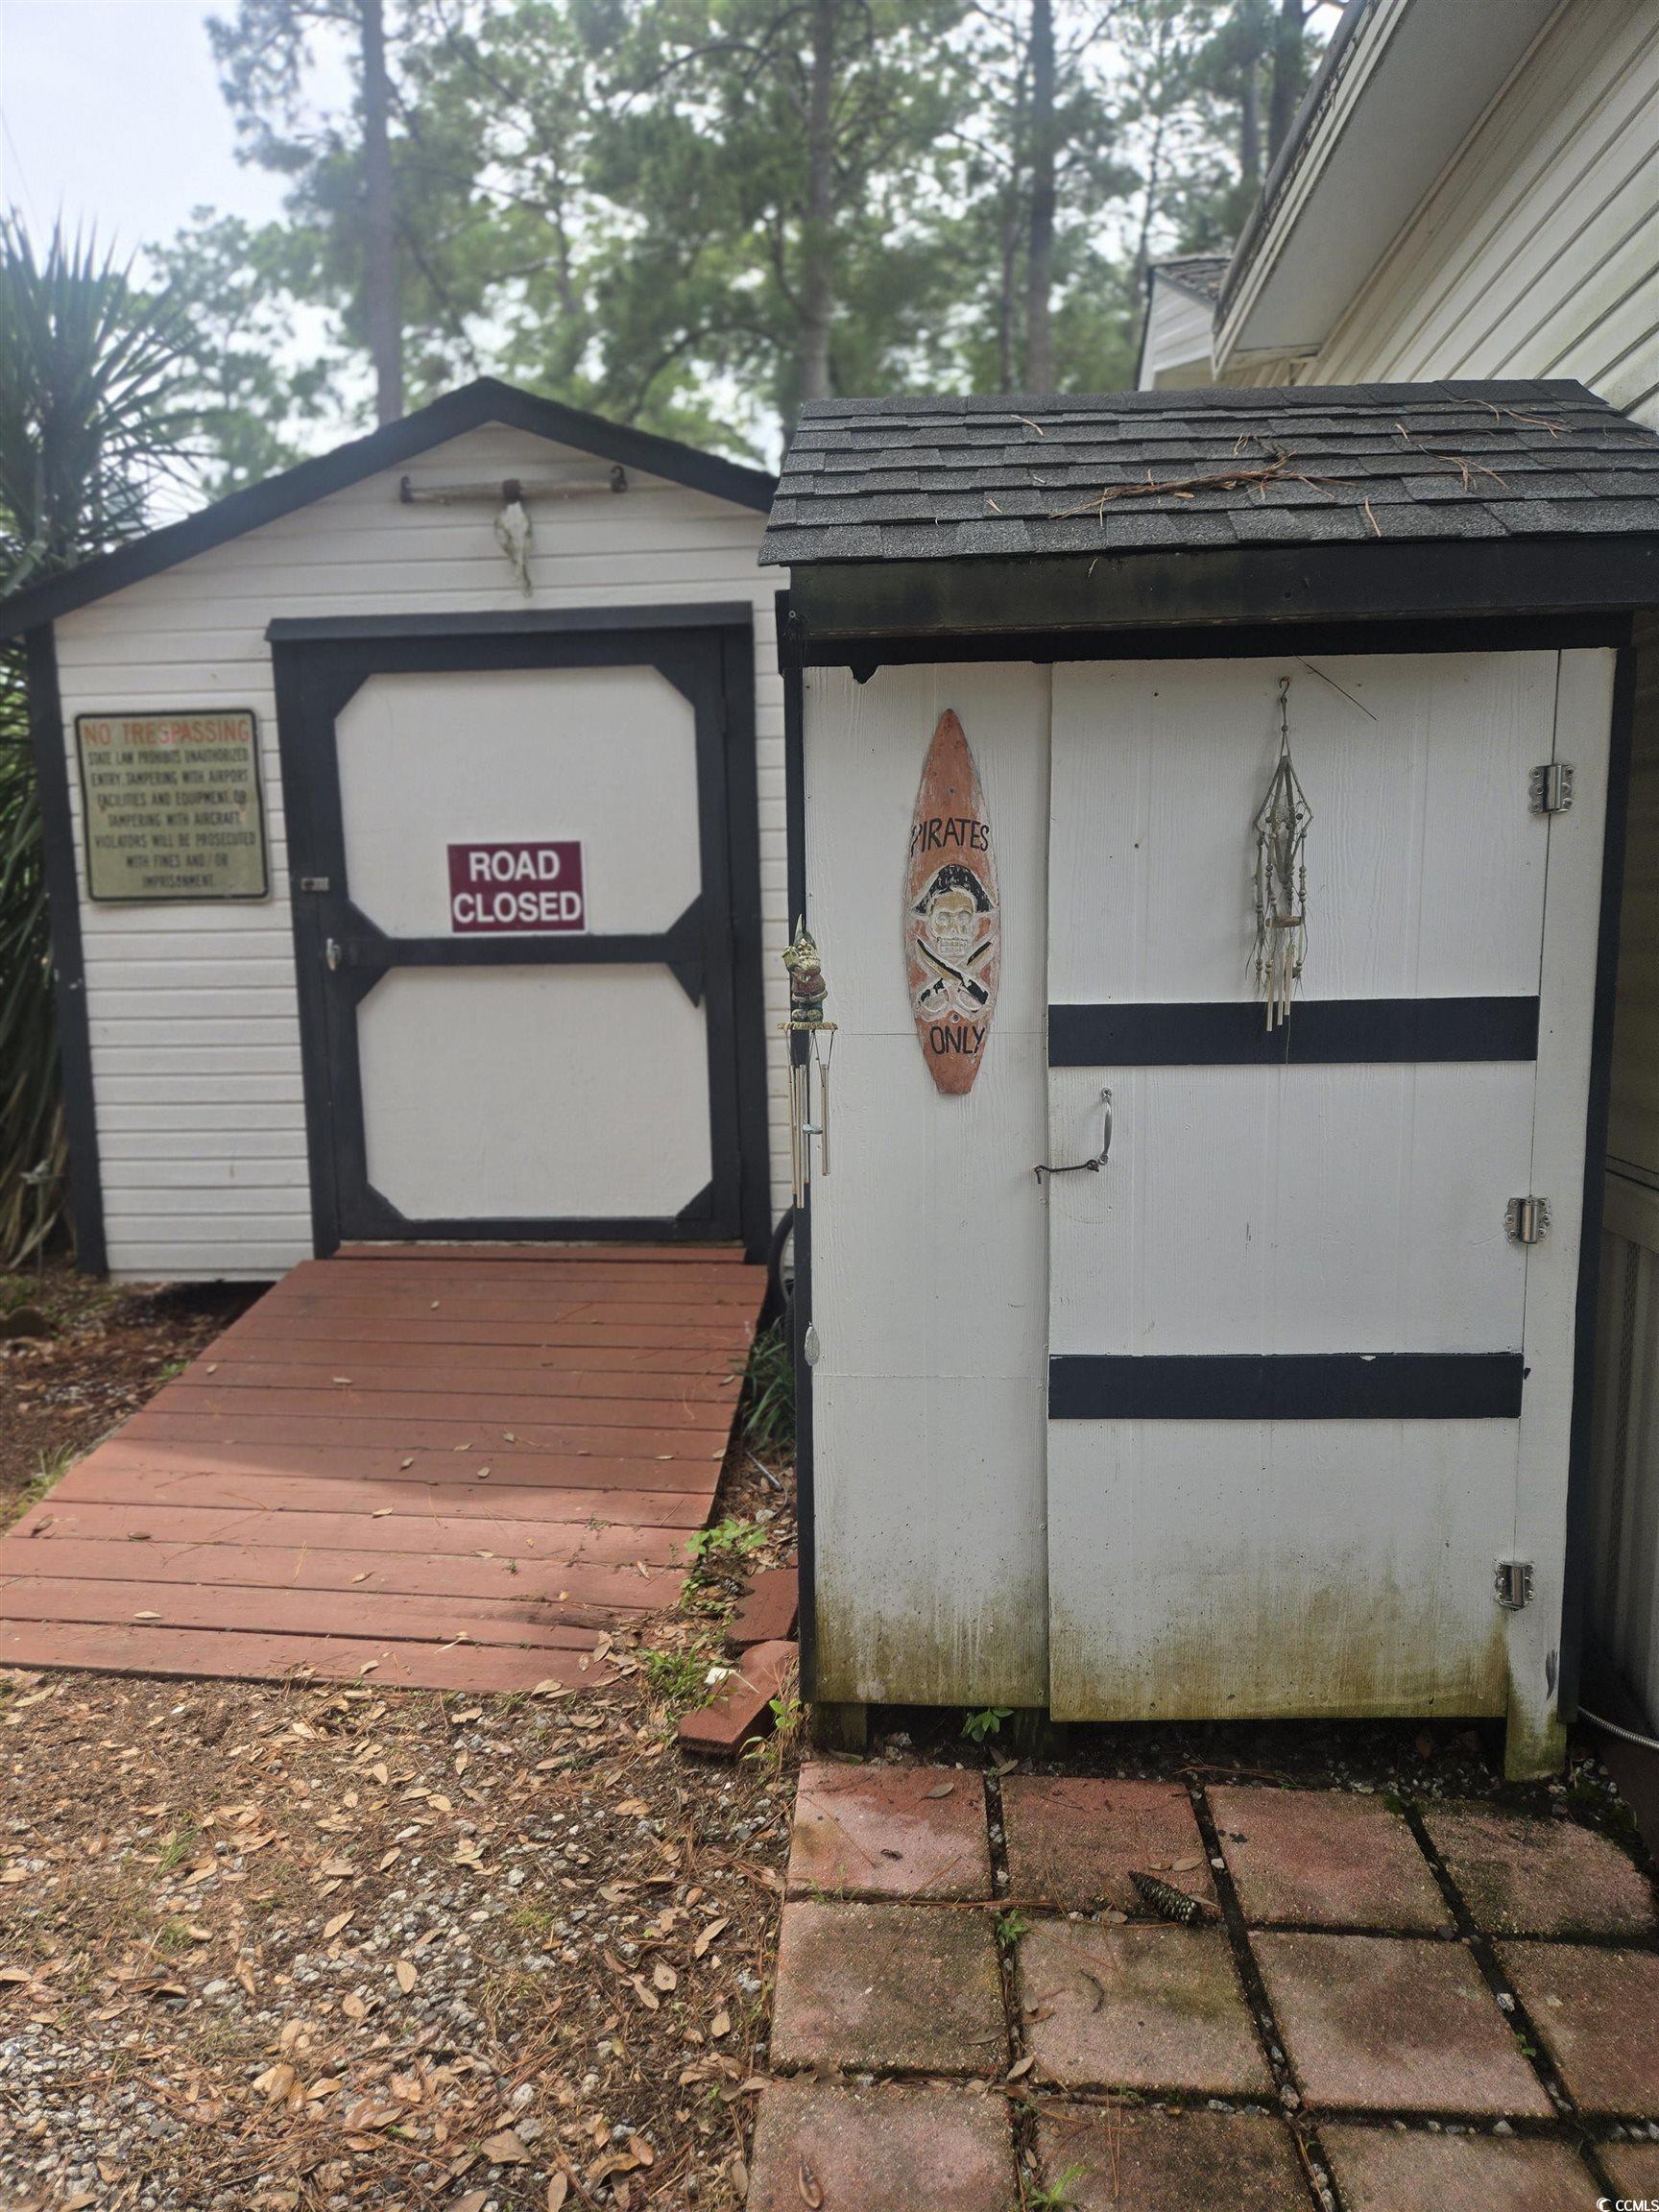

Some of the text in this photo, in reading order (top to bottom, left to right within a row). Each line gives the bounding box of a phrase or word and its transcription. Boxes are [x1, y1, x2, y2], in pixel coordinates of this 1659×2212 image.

[84, 721, 250, 746] NO TRESPASSING
[88, 751, 110, 765] STATE
[116, 751, 132, 764] LAW
[182, 770, 204, 783] WITH
[209, 769, 248, 782] AIRPORT
[152, 792, 170, 805] AND
[233, 790, 247, 805] OR
[167, 813, 188, 826] WITH
[195, 811, 241, 825] AIRCRAFT
[95, 831, 255, 848] VIOLATORS WILL BE PROSECUTED
[910, 817, 990, 858] PIRATES
[127, 855, 149, 867] WITH
[154, 854, 180, 867] FINES
[469, 850, 561, 882] ROAD
[453, 891, 582, 924] CLOSED
[929, 1025, 986, 1054] ONLY
